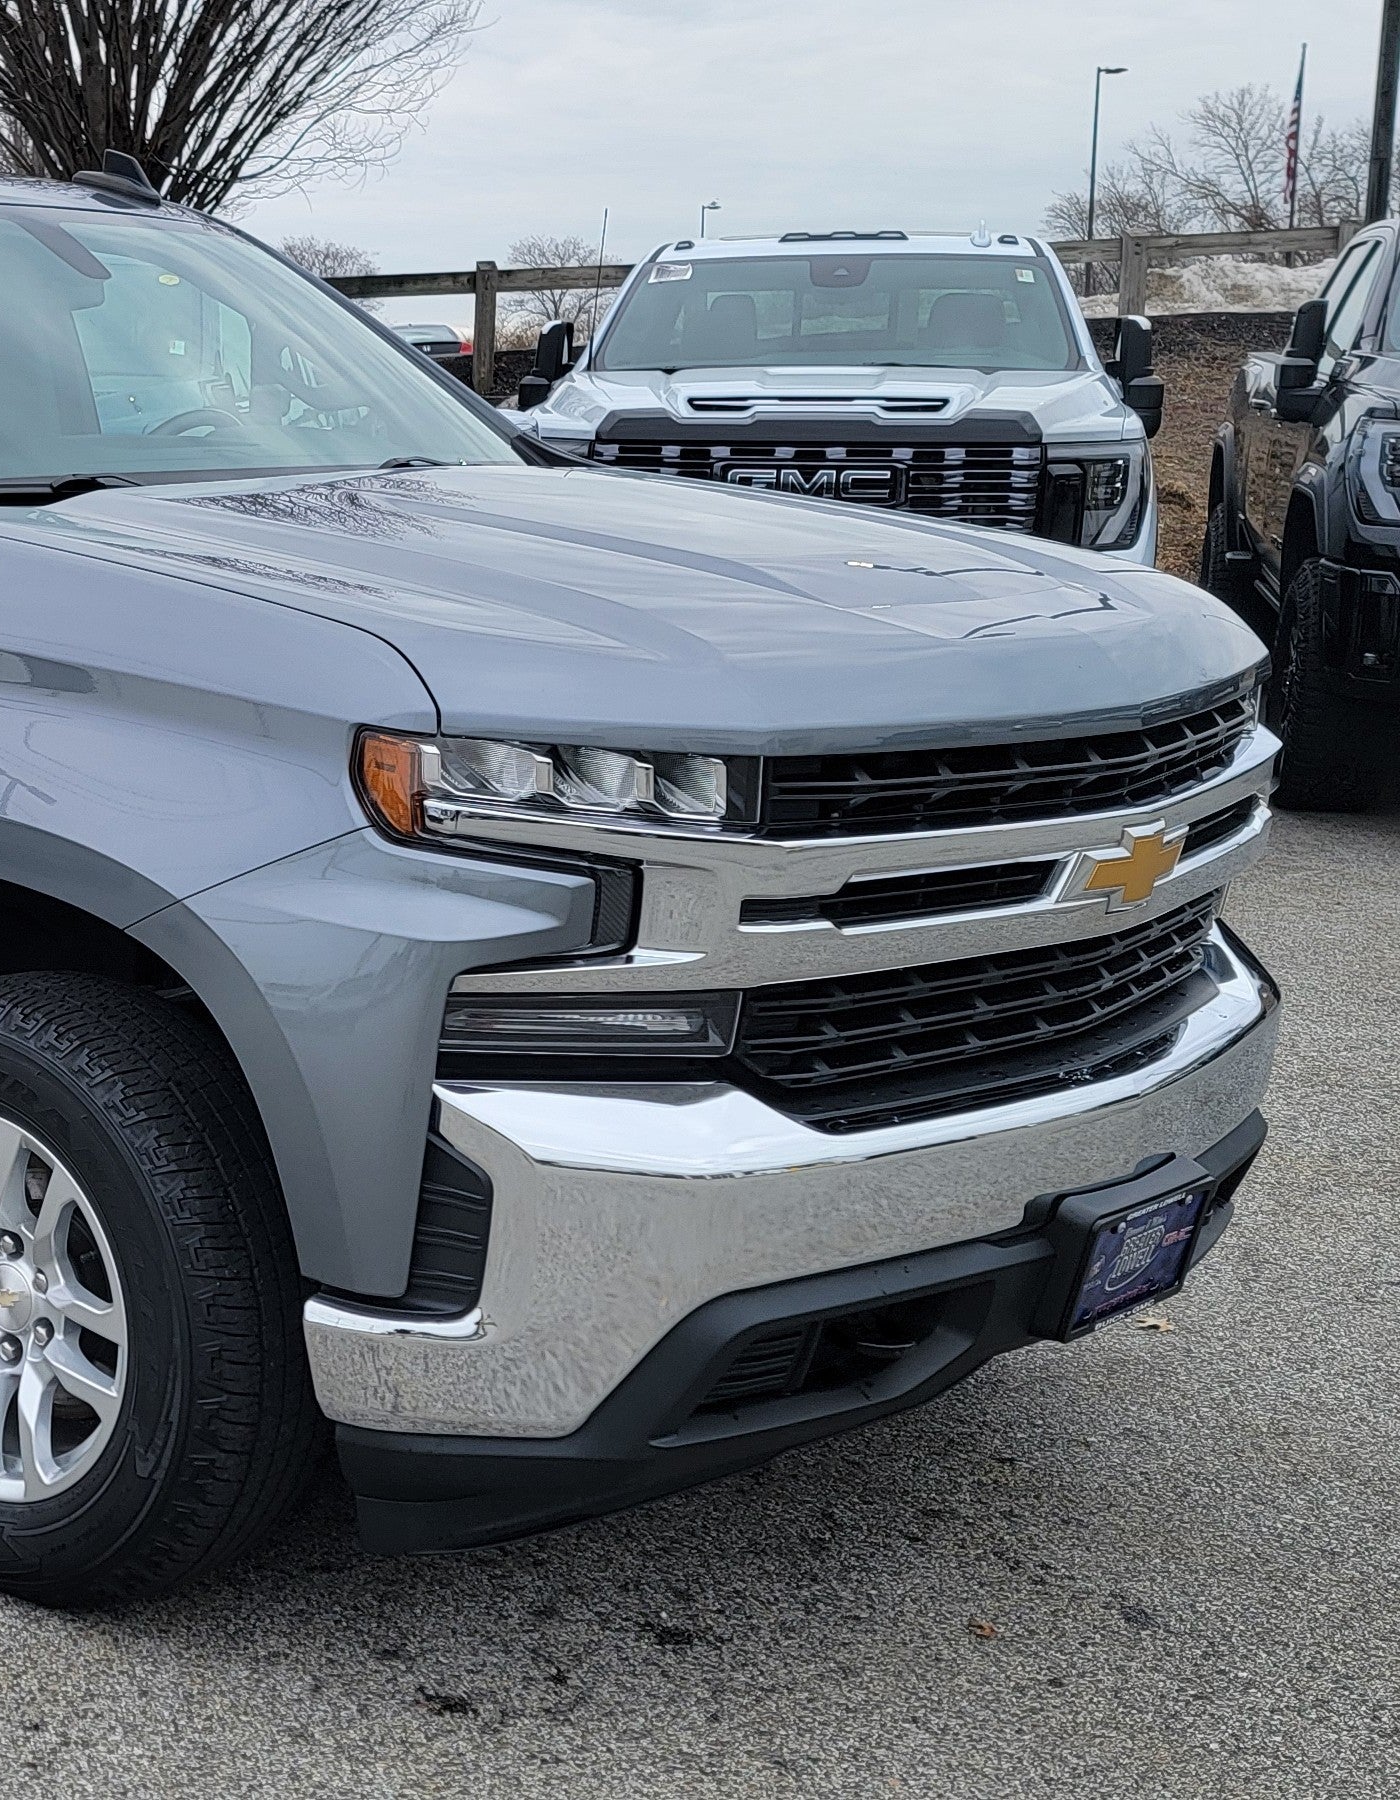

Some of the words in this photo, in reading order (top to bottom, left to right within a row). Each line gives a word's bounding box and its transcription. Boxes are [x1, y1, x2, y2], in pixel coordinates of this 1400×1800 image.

[727, 469, 892, 498] GMC
[1111, 1245, 1155, 1278] LOWELL
[1094, 1314, 1126, 1331] BUICK
[1132, 1299, 1156, 1313] GMC
